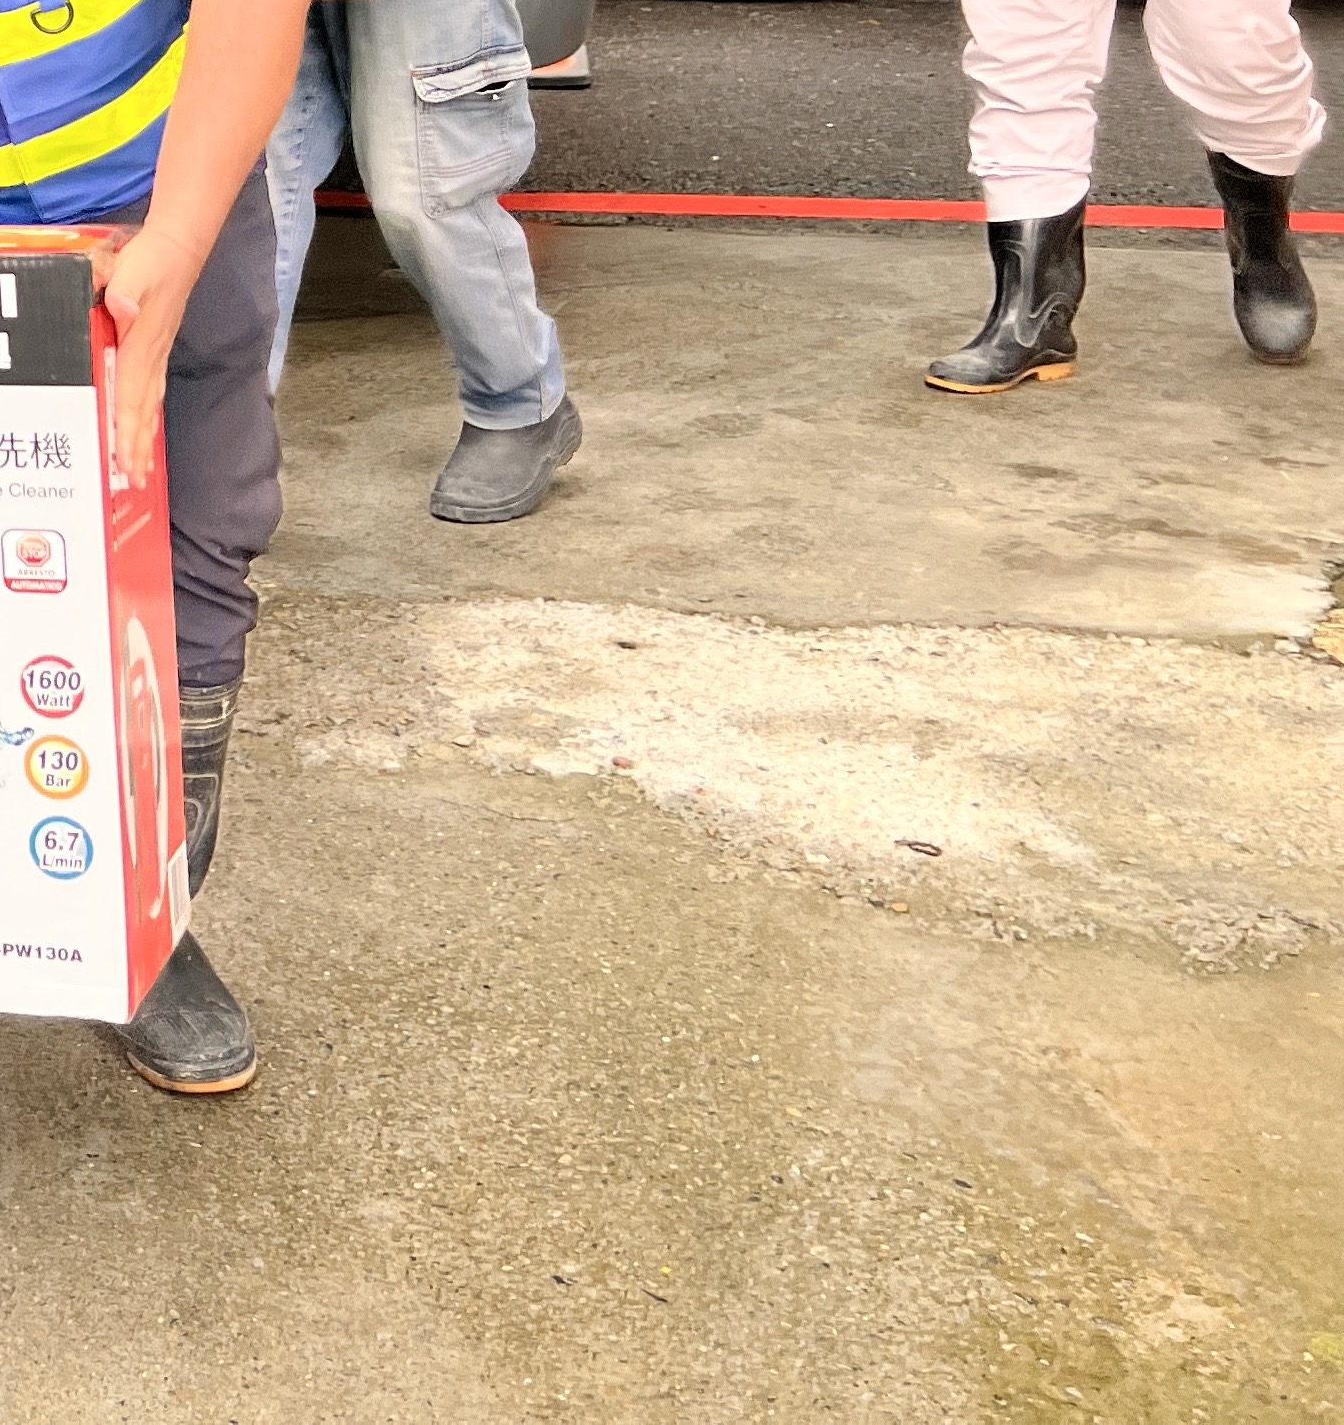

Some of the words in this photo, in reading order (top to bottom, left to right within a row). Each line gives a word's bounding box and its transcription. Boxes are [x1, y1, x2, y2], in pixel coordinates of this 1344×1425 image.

[8, 481, 75, 499] Cleaner
[26, 669, 81, 691] 1600
[37, 693, 70, 708] Watt
[38, 750, 79, 771] 130
[45, 774, 71, 787] Bar
[44, 830, 79, 851] 6.7
[42, 854, 83, 868] L/min
